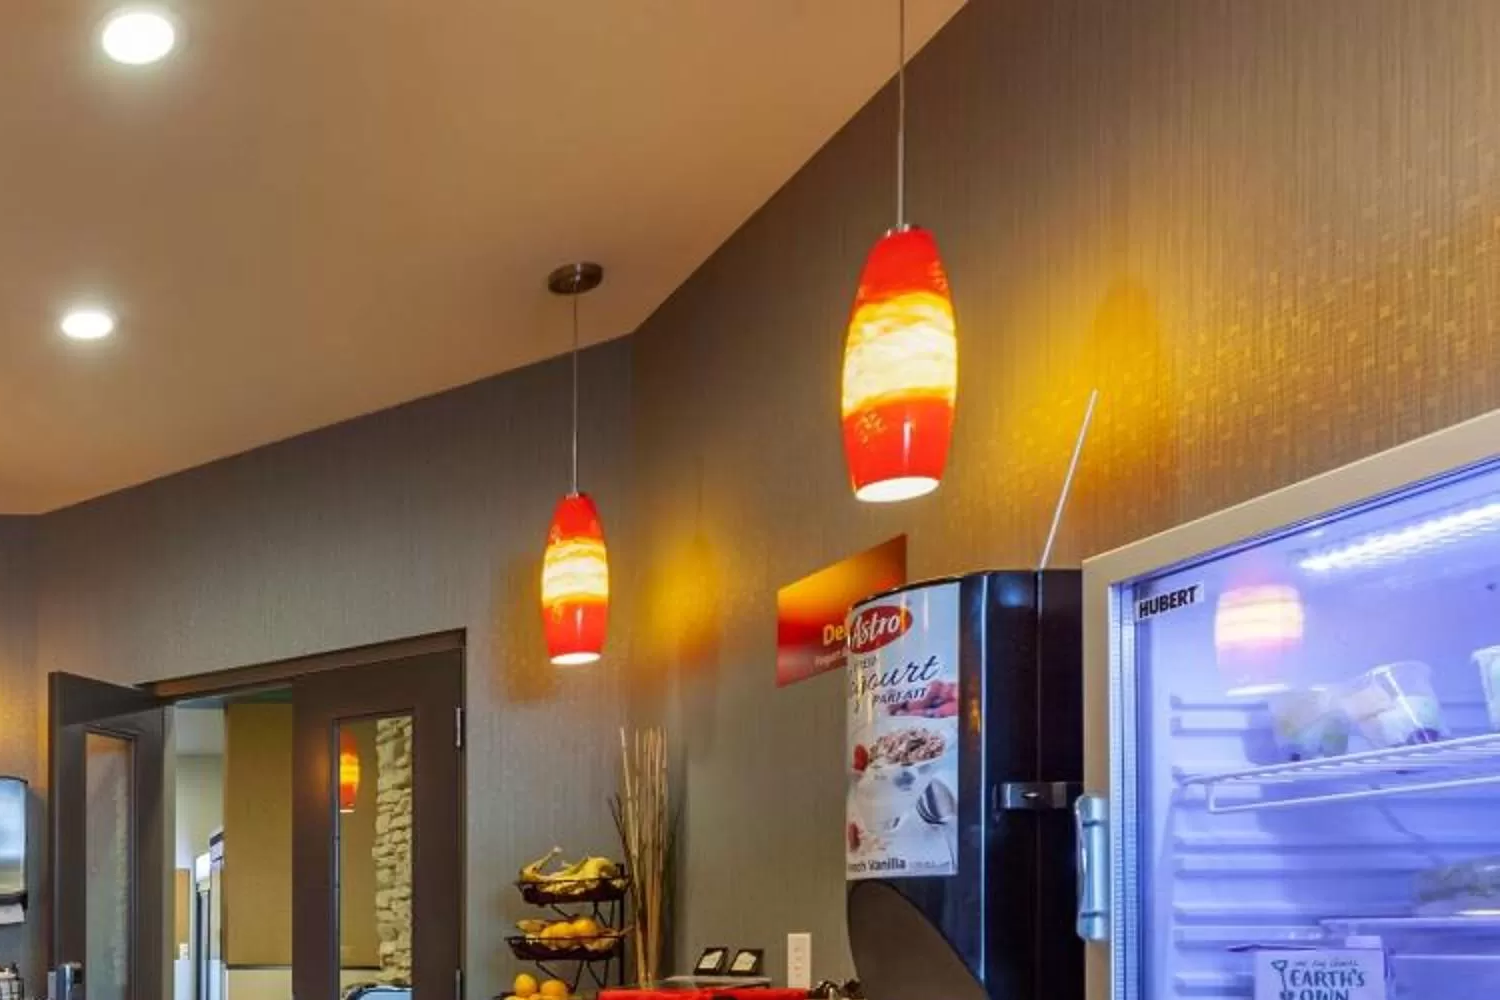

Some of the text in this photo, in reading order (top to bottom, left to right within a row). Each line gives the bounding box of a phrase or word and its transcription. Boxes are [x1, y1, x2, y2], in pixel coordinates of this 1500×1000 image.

[1139, 584, 1199, 618] HUBERT
[822, 622, 849, 646] De
[851, 611, 901, 649] Astro
[867, 857, 907, 871] Vanilla
[1289, 968, 1366, 988] EARTH'S
